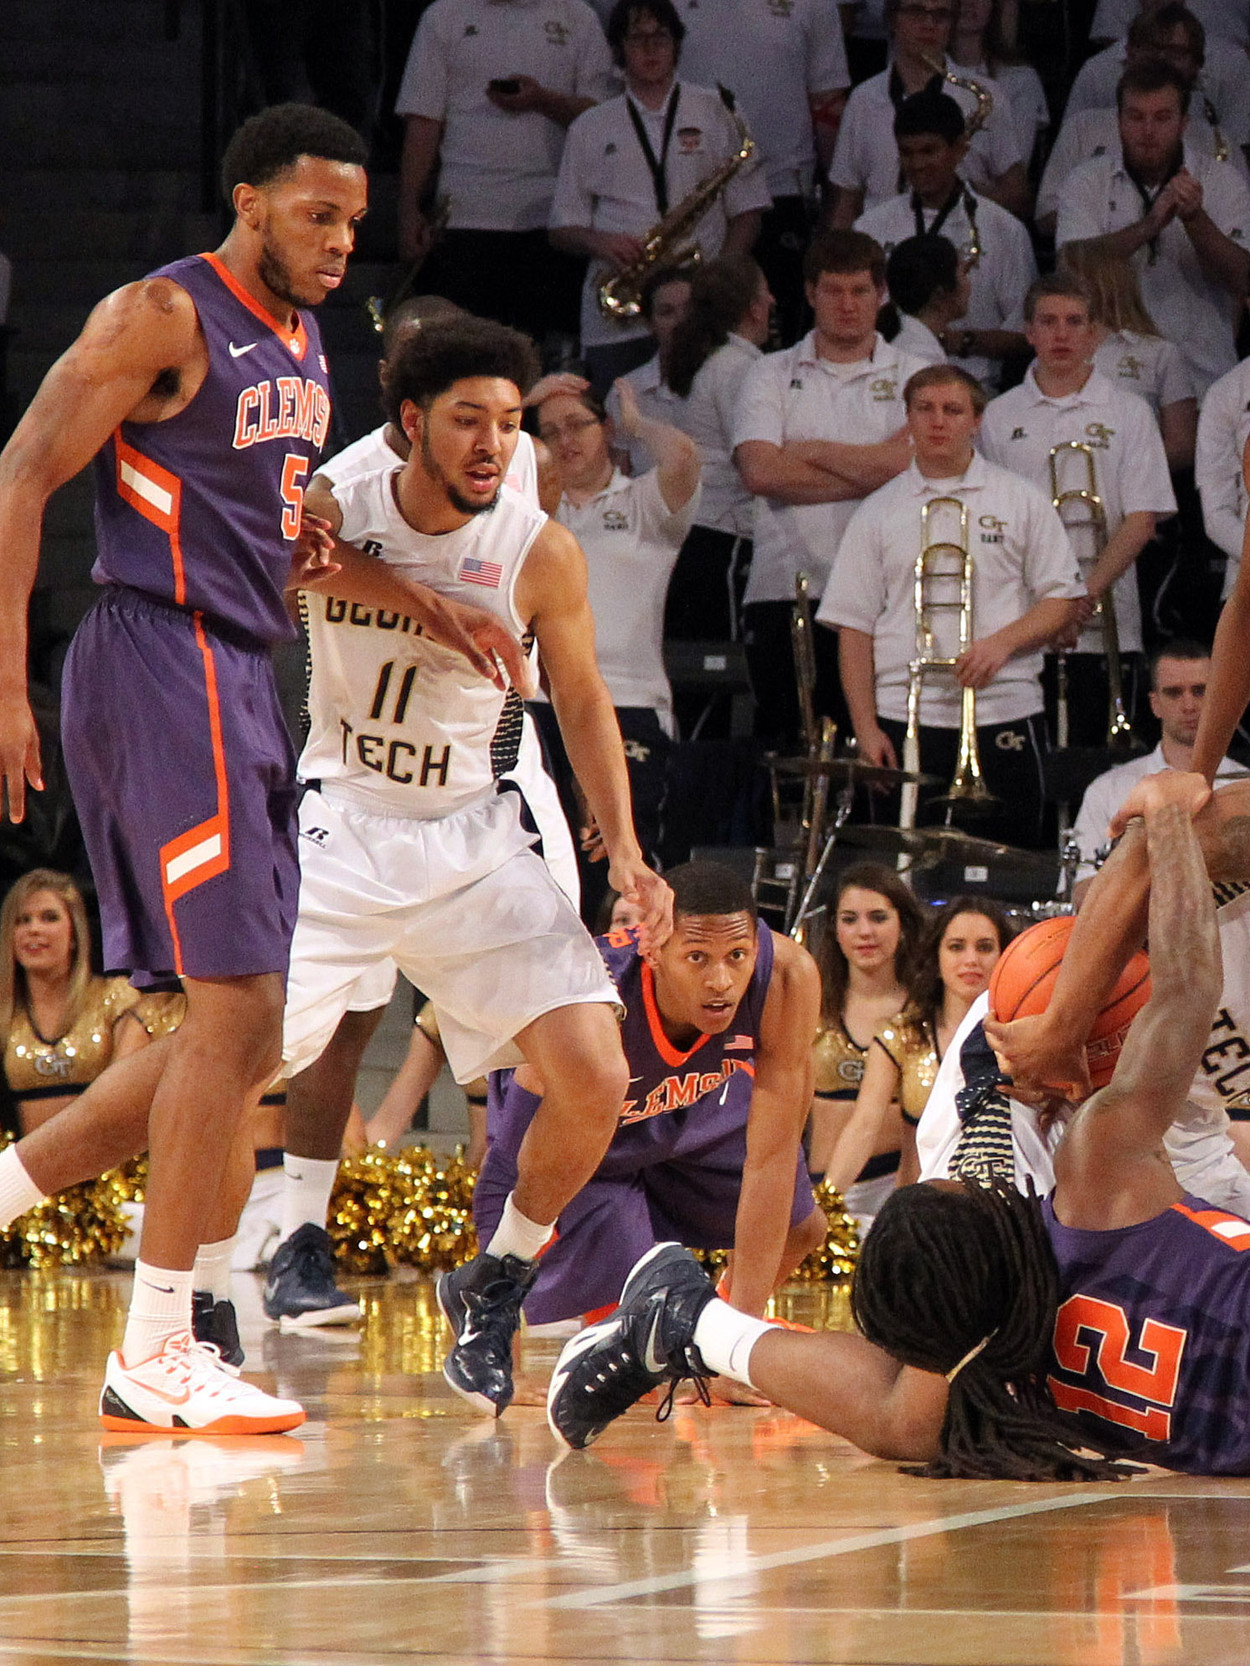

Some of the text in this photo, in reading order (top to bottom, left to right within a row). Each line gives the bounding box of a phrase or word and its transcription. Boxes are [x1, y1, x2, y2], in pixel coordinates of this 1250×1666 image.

[232, 376, 331, 451] CLEMS
[280, 453, 309, 541] 5
[370, 659, 417, 724] 11
[340, 718, 451, 787] TECH
[1046, 1293, 1187, 1444] 12
